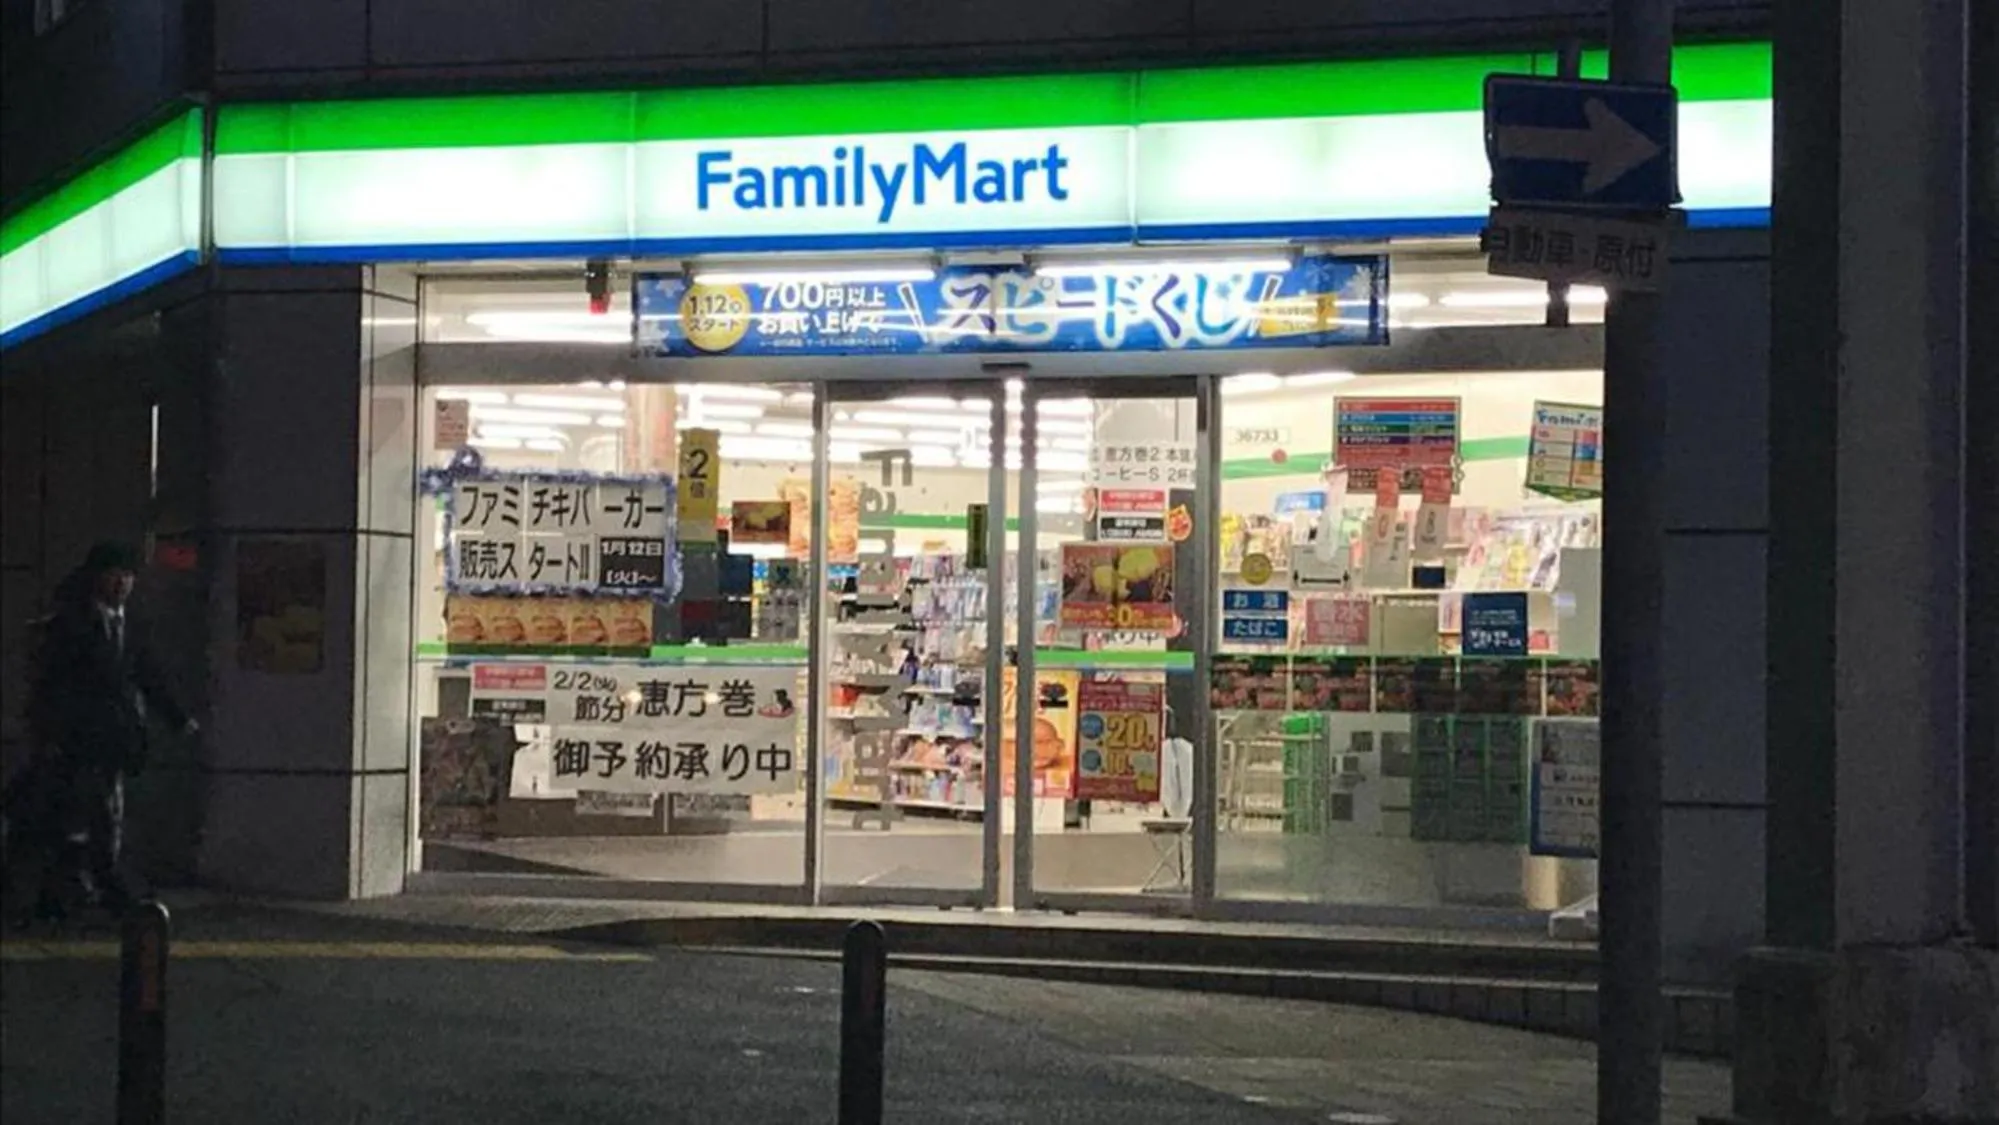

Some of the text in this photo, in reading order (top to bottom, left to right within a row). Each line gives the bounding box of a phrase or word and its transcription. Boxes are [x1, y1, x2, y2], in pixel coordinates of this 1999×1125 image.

[696, 142, 1068, 222] FamilyMart
[689, 317, 740, 332] スタート
[945, 272, 1248, 346] スピードくじ
[602, 540, 663, 557] 1月12日
[1233, 620, 1280, 636] たばこ
[574, 695, 627, 723] 節分
[636, 679, 756, 718] 恵方巻
[553, 739, 793, 782] 御予約承り中
